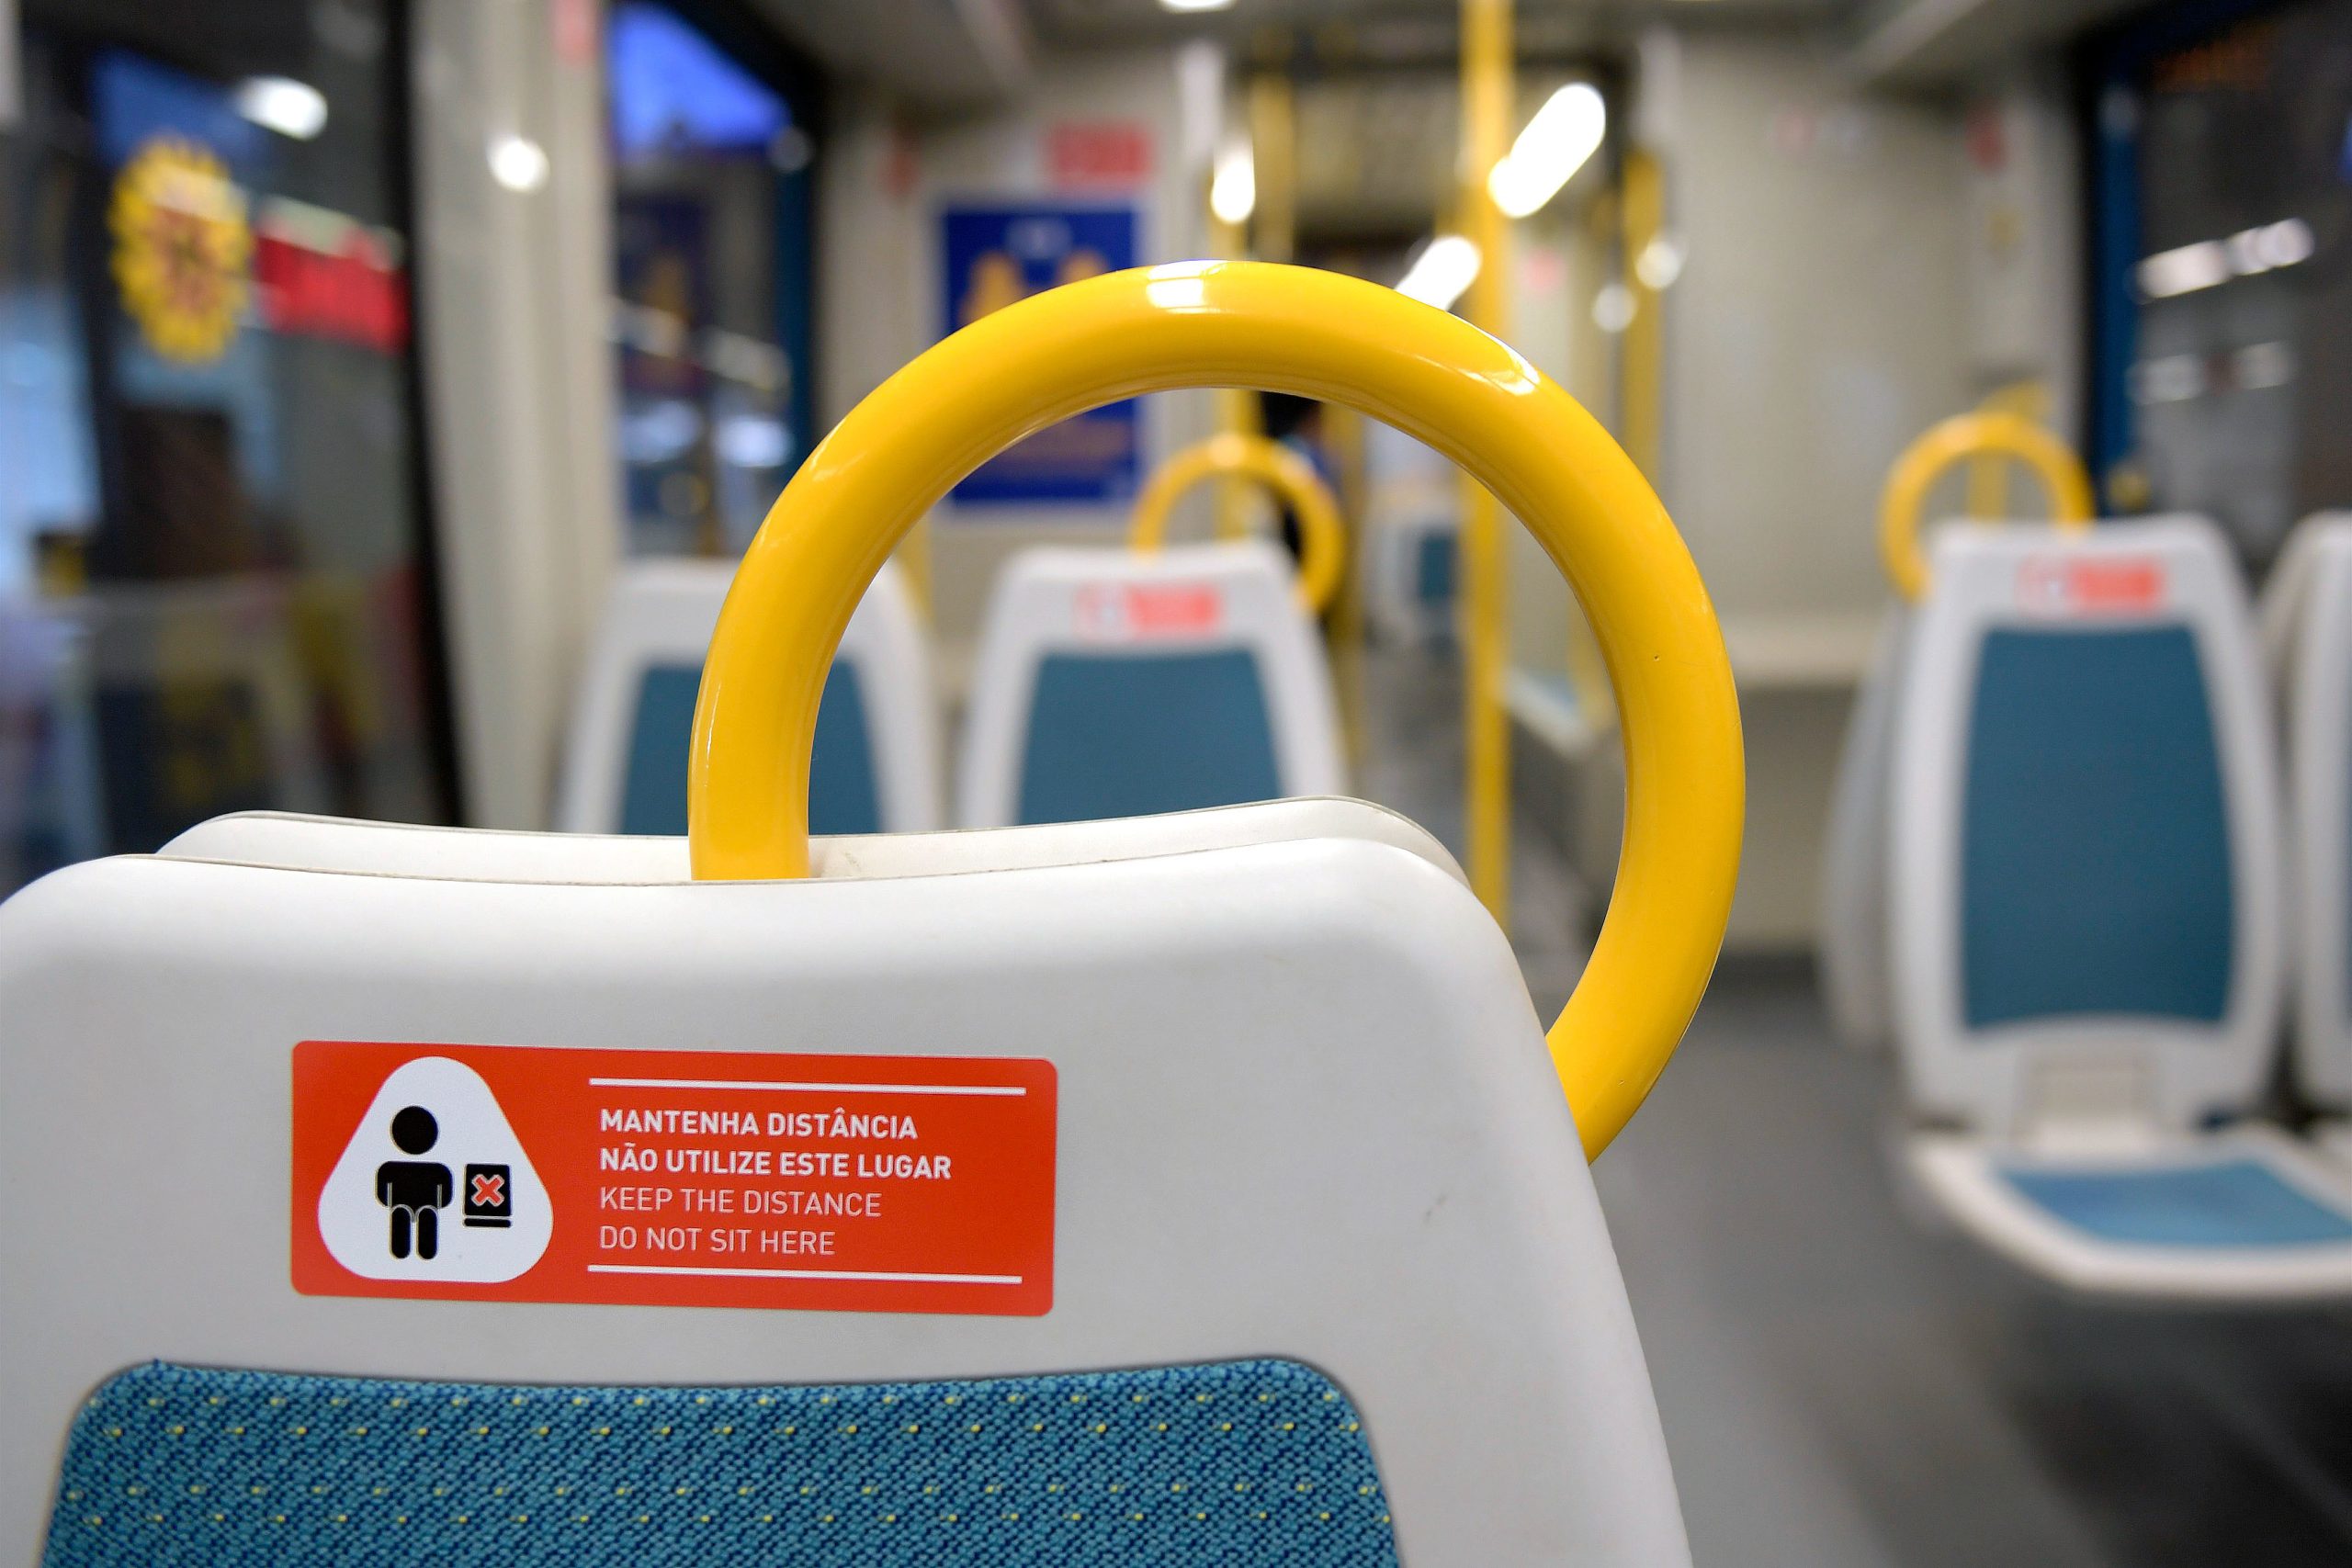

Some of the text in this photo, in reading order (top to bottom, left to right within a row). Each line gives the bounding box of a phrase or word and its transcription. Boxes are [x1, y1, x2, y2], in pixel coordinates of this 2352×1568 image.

[600, 1107, 918, 1140] MANTENHA DISTÂNCIA
[600, 1142, 952, 1179] NÃO UTILIZE ESTE LUGAR
[600, 1187, 882, 1217] KEEP THE DISTANCE
[600, 1225, 836, 1256] DO NOT SIT HERE
